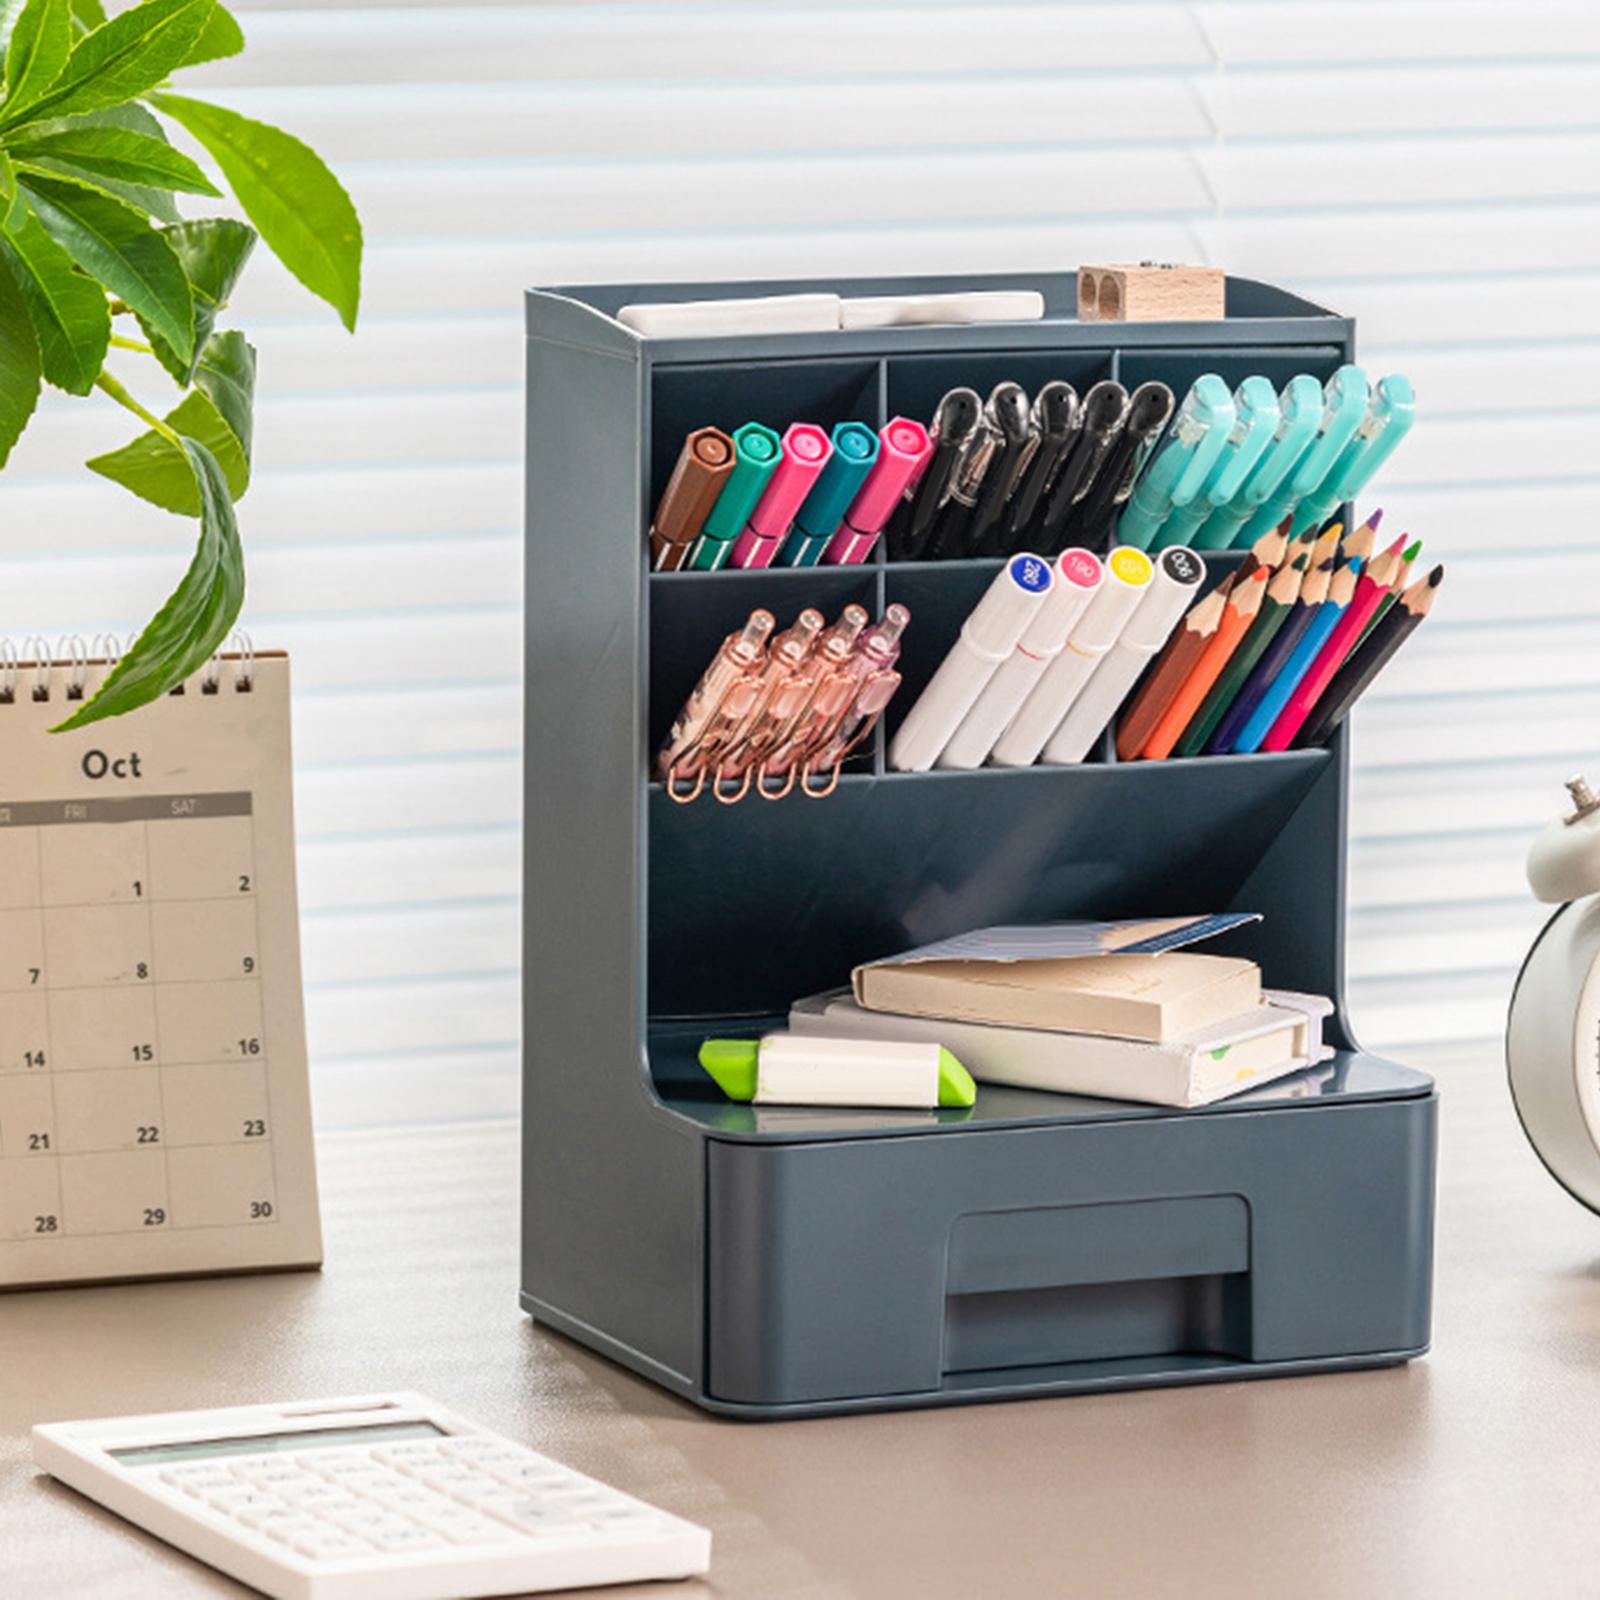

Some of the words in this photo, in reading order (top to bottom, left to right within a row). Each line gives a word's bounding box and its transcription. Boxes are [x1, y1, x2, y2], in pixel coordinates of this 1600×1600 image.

[81, 750, 142, 779] Oct
[64, 804, 87, 819] FRI
[171, 800, 197, 815] SAT
[133, 881, 142, 896] 1
[239, 876, 250, 891] 2
[28, 968, 40, 984] 7
[136, 963, 148, 979] 8
[243, 957, 254, 973] 9
[24, 1051, 45, 1067] 14
[132, 1045, 153, 1061] 15
[239, 1039, 260, 1055] 16
[29, 1134, 50, 1150] 21
[137, 1127, 159, 1144] 22
[244, 1120, 266, 1137] 23
[35, 1216, 57, 1233] 28
[143, 1209, 165, 1226] 29
[250, 1202, 272, 1218] 30
